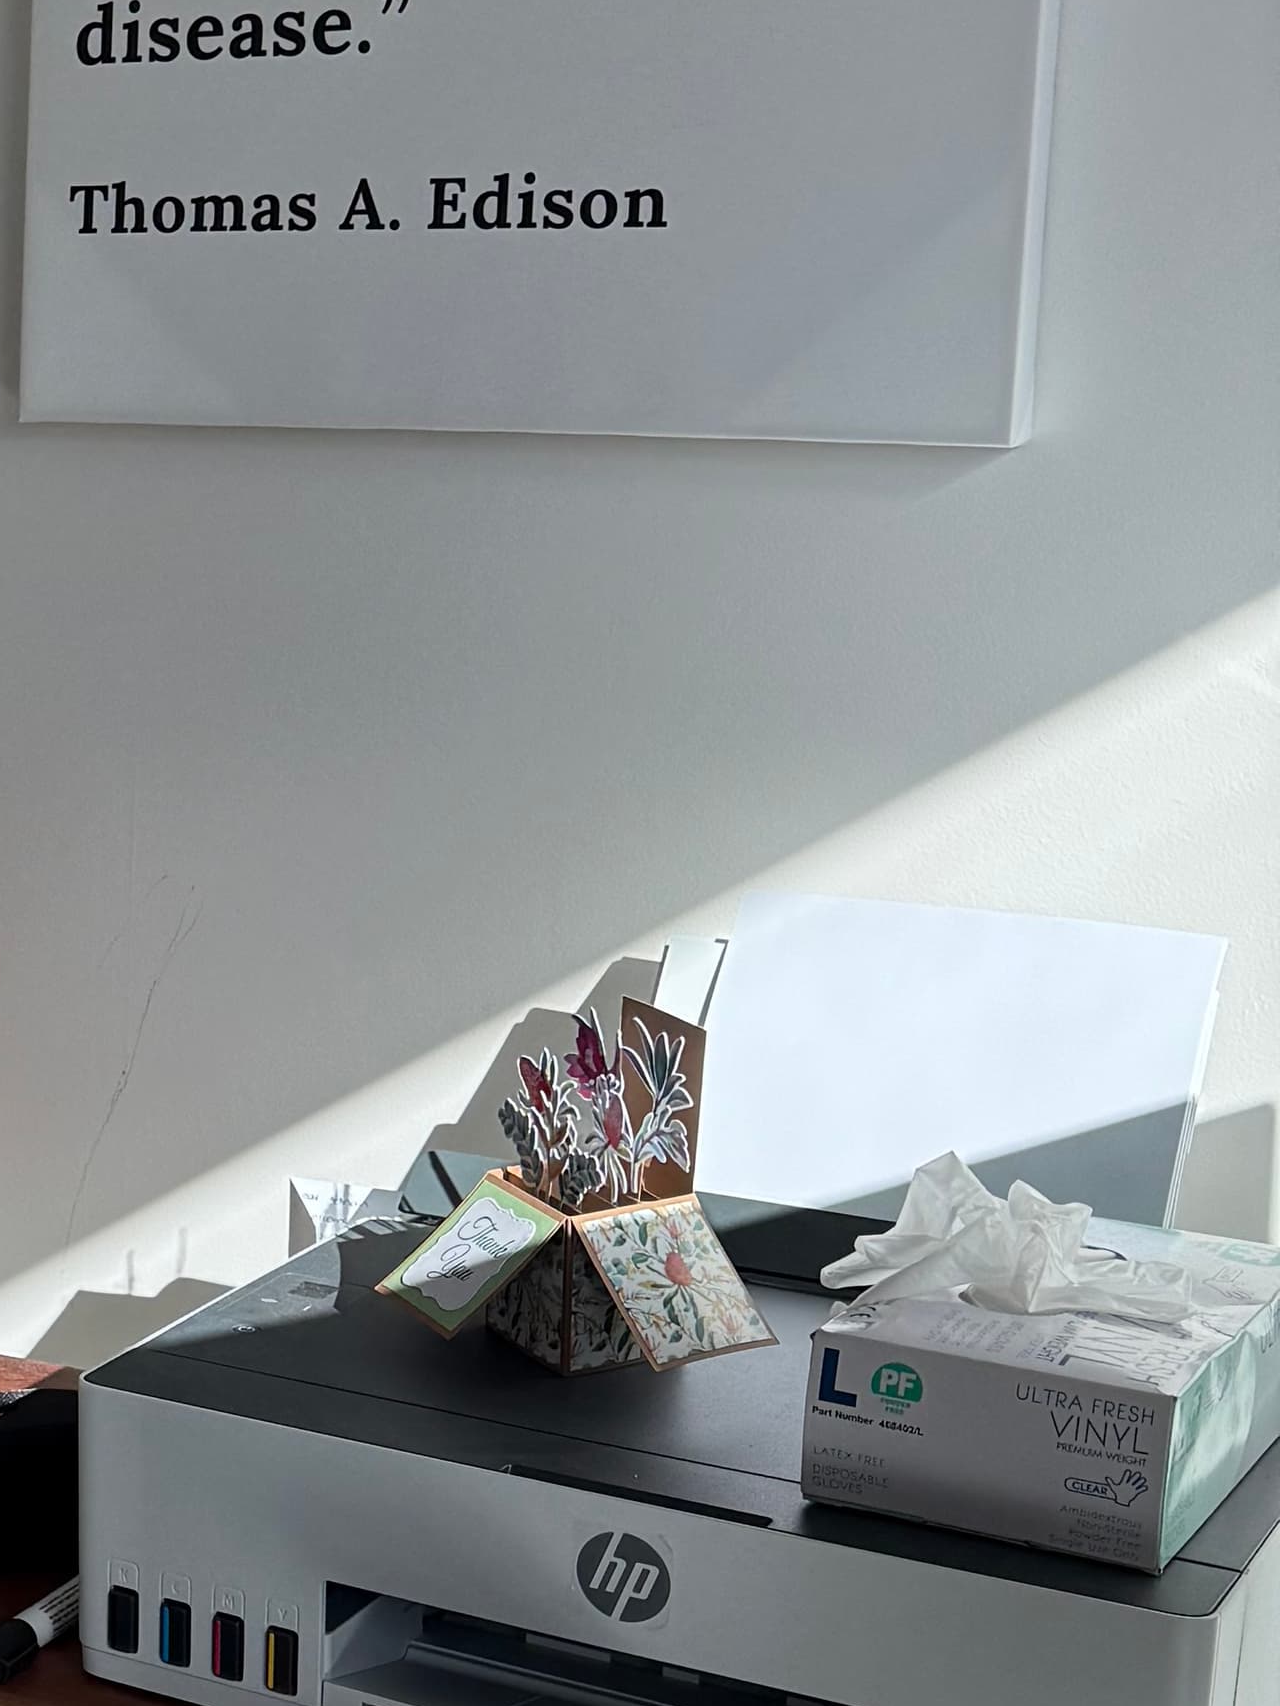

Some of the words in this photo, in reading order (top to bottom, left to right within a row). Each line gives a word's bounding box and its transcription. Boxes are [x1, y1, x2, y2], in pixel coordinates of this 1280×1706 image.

[69, 180, 317, 235] Thomas
[338, 177, 401, 231] A.
[427, 171, 668, 230] Edison
[457, 1215, 516, 1260] Thank
[426, 1243, 474, 1282] You
[1058, 1312, 1174, 1368] VNYL
[818, 1347, 858, 1408] L
[879, 1367, 918, 1398] PF
[811, 1405, 833, 1418] Part
[834, 1408, 875, 1426] Number
[1015, 1382, 1083, 1413] ULTRA
[1091, 1397, 1156, 1427] FRESH
[1050, 1410, 1150, 1456] VINYL
[589, 1531, 661, 1622] hp
